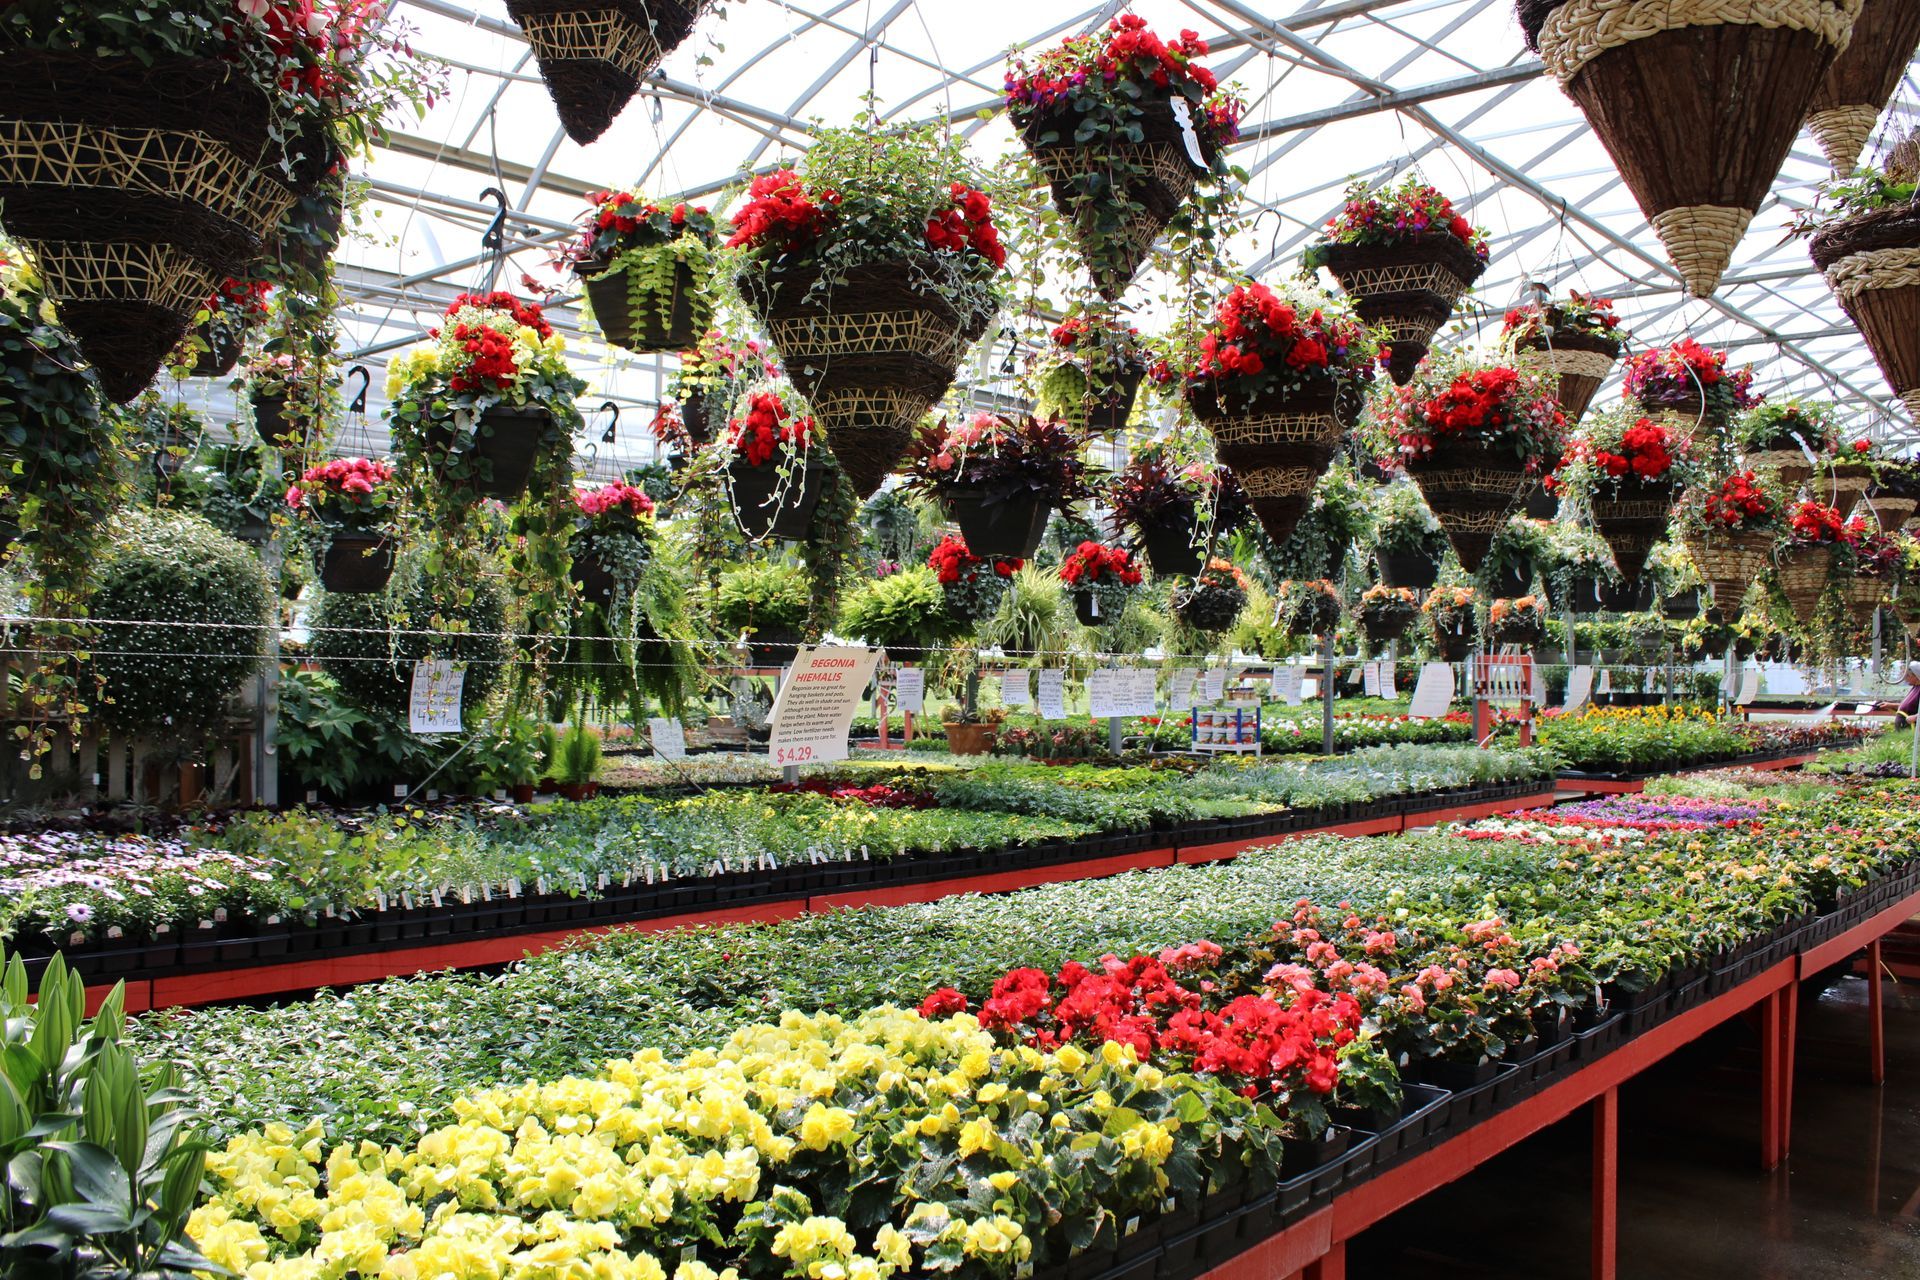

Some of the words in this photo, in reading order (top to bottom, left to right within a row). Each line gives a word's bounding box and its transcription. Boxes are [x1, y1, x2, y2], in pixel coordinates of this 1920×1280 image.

[811, 659, 855, 668] BEGONIA
[796, 672, 842, 682] HIEMALIS
[777, 747, 784, 764] $
[787, 746, 812, 761] 4.29
